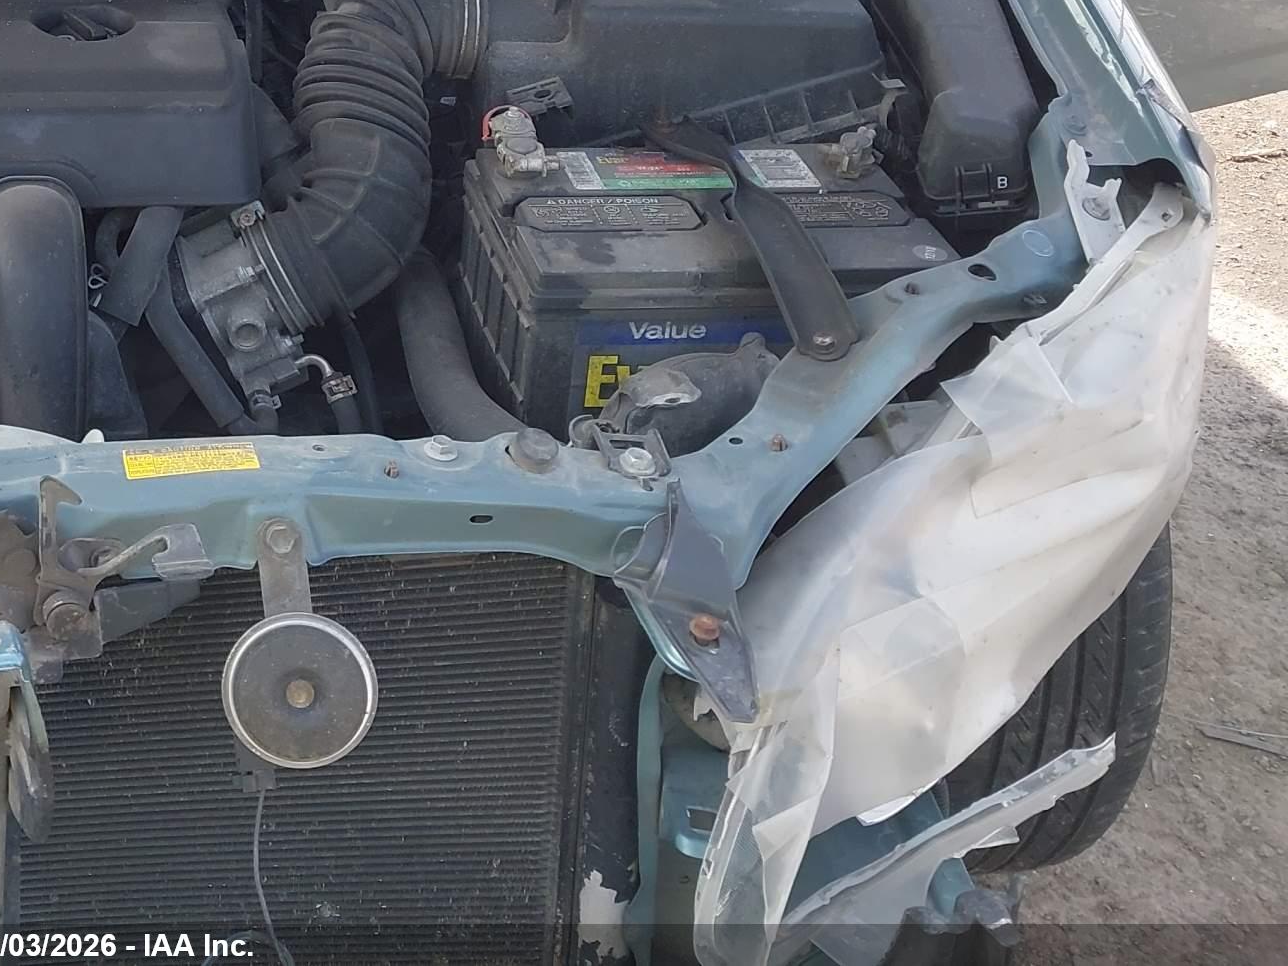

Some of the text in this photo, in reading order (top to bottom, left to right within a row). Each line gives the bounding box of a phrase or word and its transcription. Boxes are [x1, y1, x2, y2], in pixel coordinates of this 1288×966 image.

[996, 176, 1009, 189] B
[615, 197, 659, 205] POISON
[628, 321, 708, 340] Value
